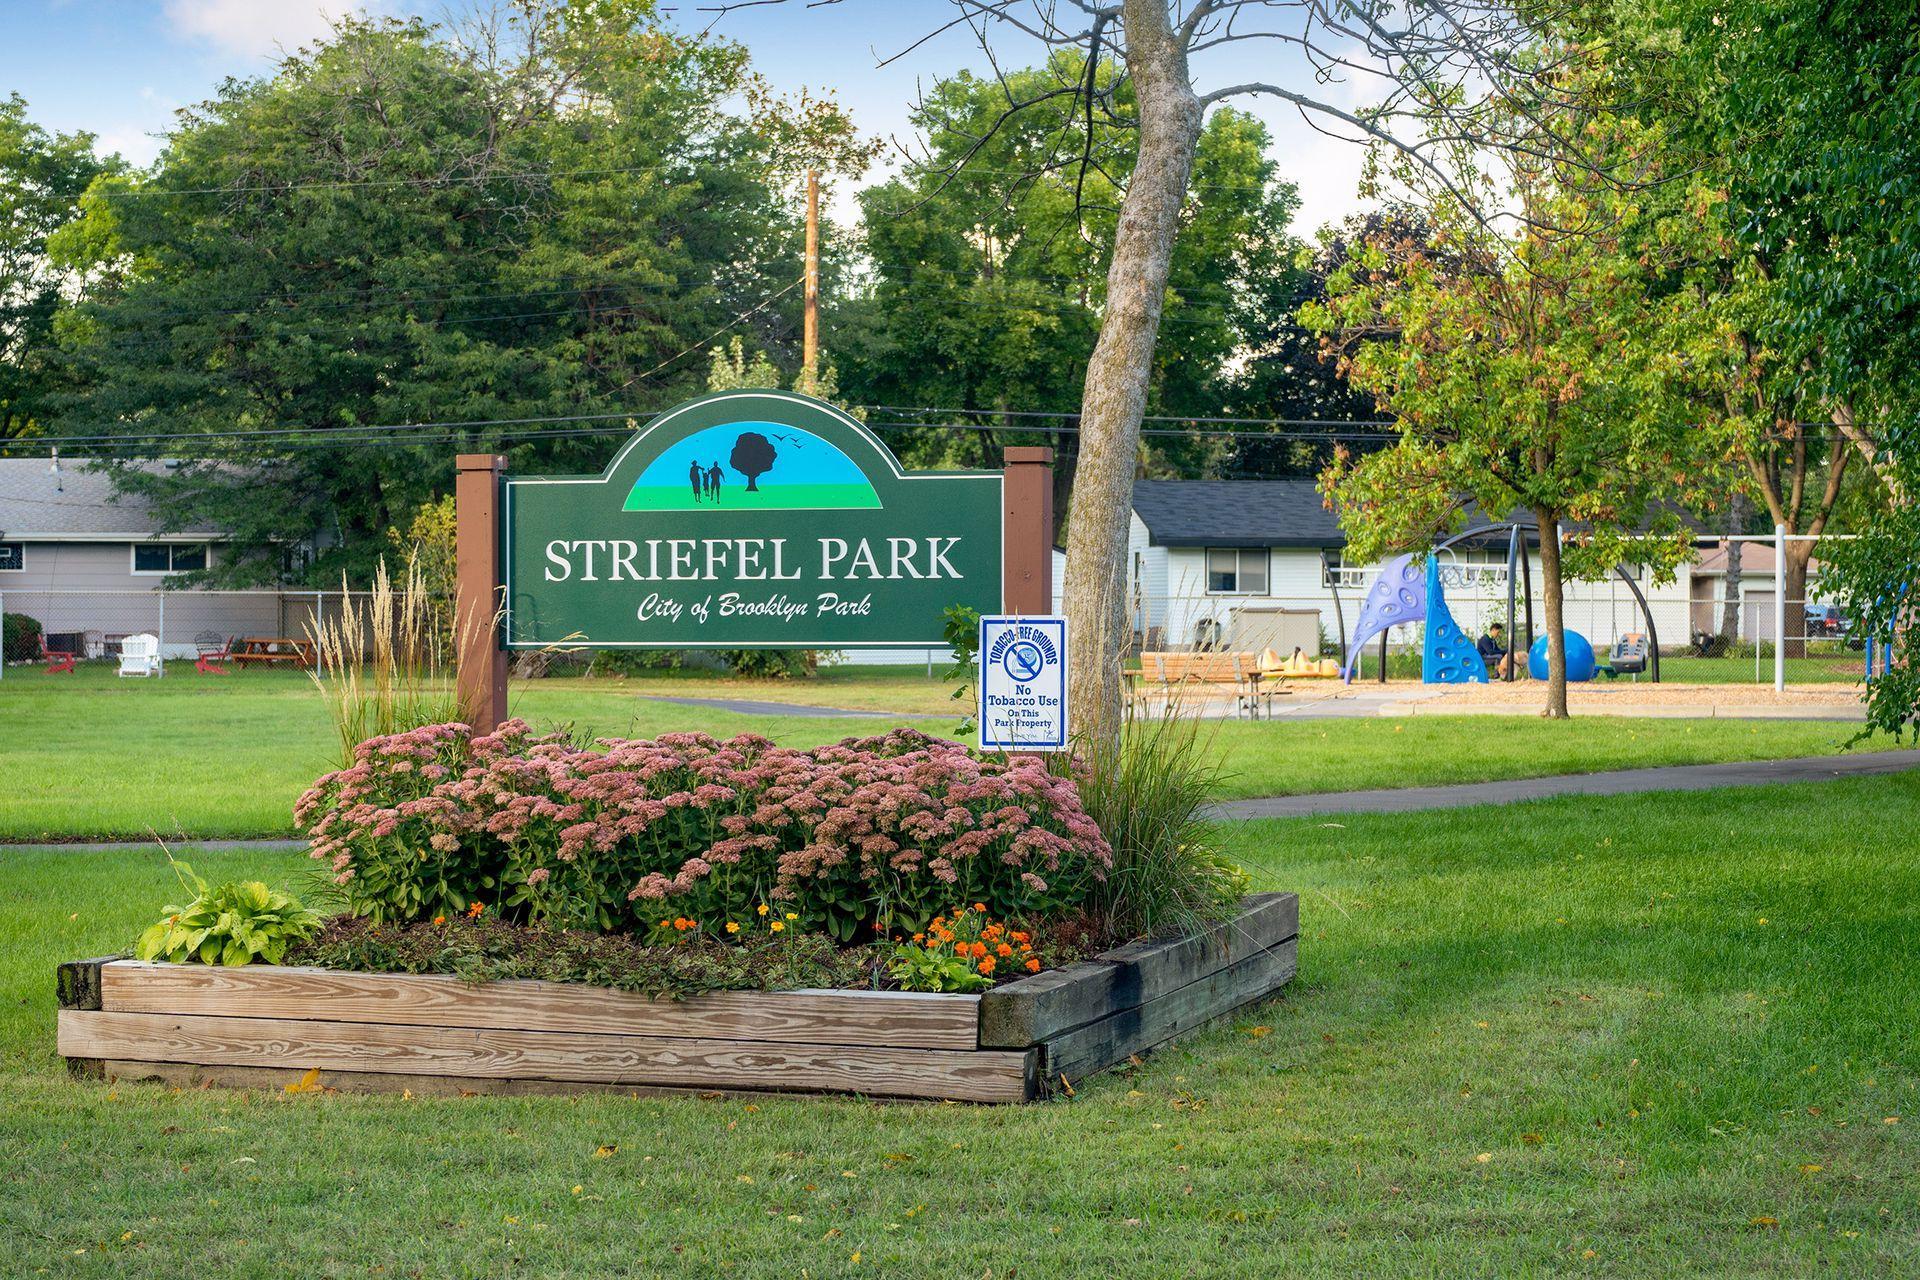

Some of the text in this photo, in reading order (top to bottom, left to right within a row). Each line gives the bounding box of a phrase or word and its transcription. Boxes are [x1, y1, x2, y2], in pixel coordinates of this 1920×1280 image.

[545, 537, 964, 582] STRIEFEL PARK
[637, 592, 872, 624] City of Brooklyn Park
[1032, 629, 1058, 665] GROUNDS
[1015, 685, 1031, 695] No
[988, 695, 1058, 706] Tobacco Use
[1008, 709, 1039, 717] On This
[995, 719, 1052, 729] Park Property
